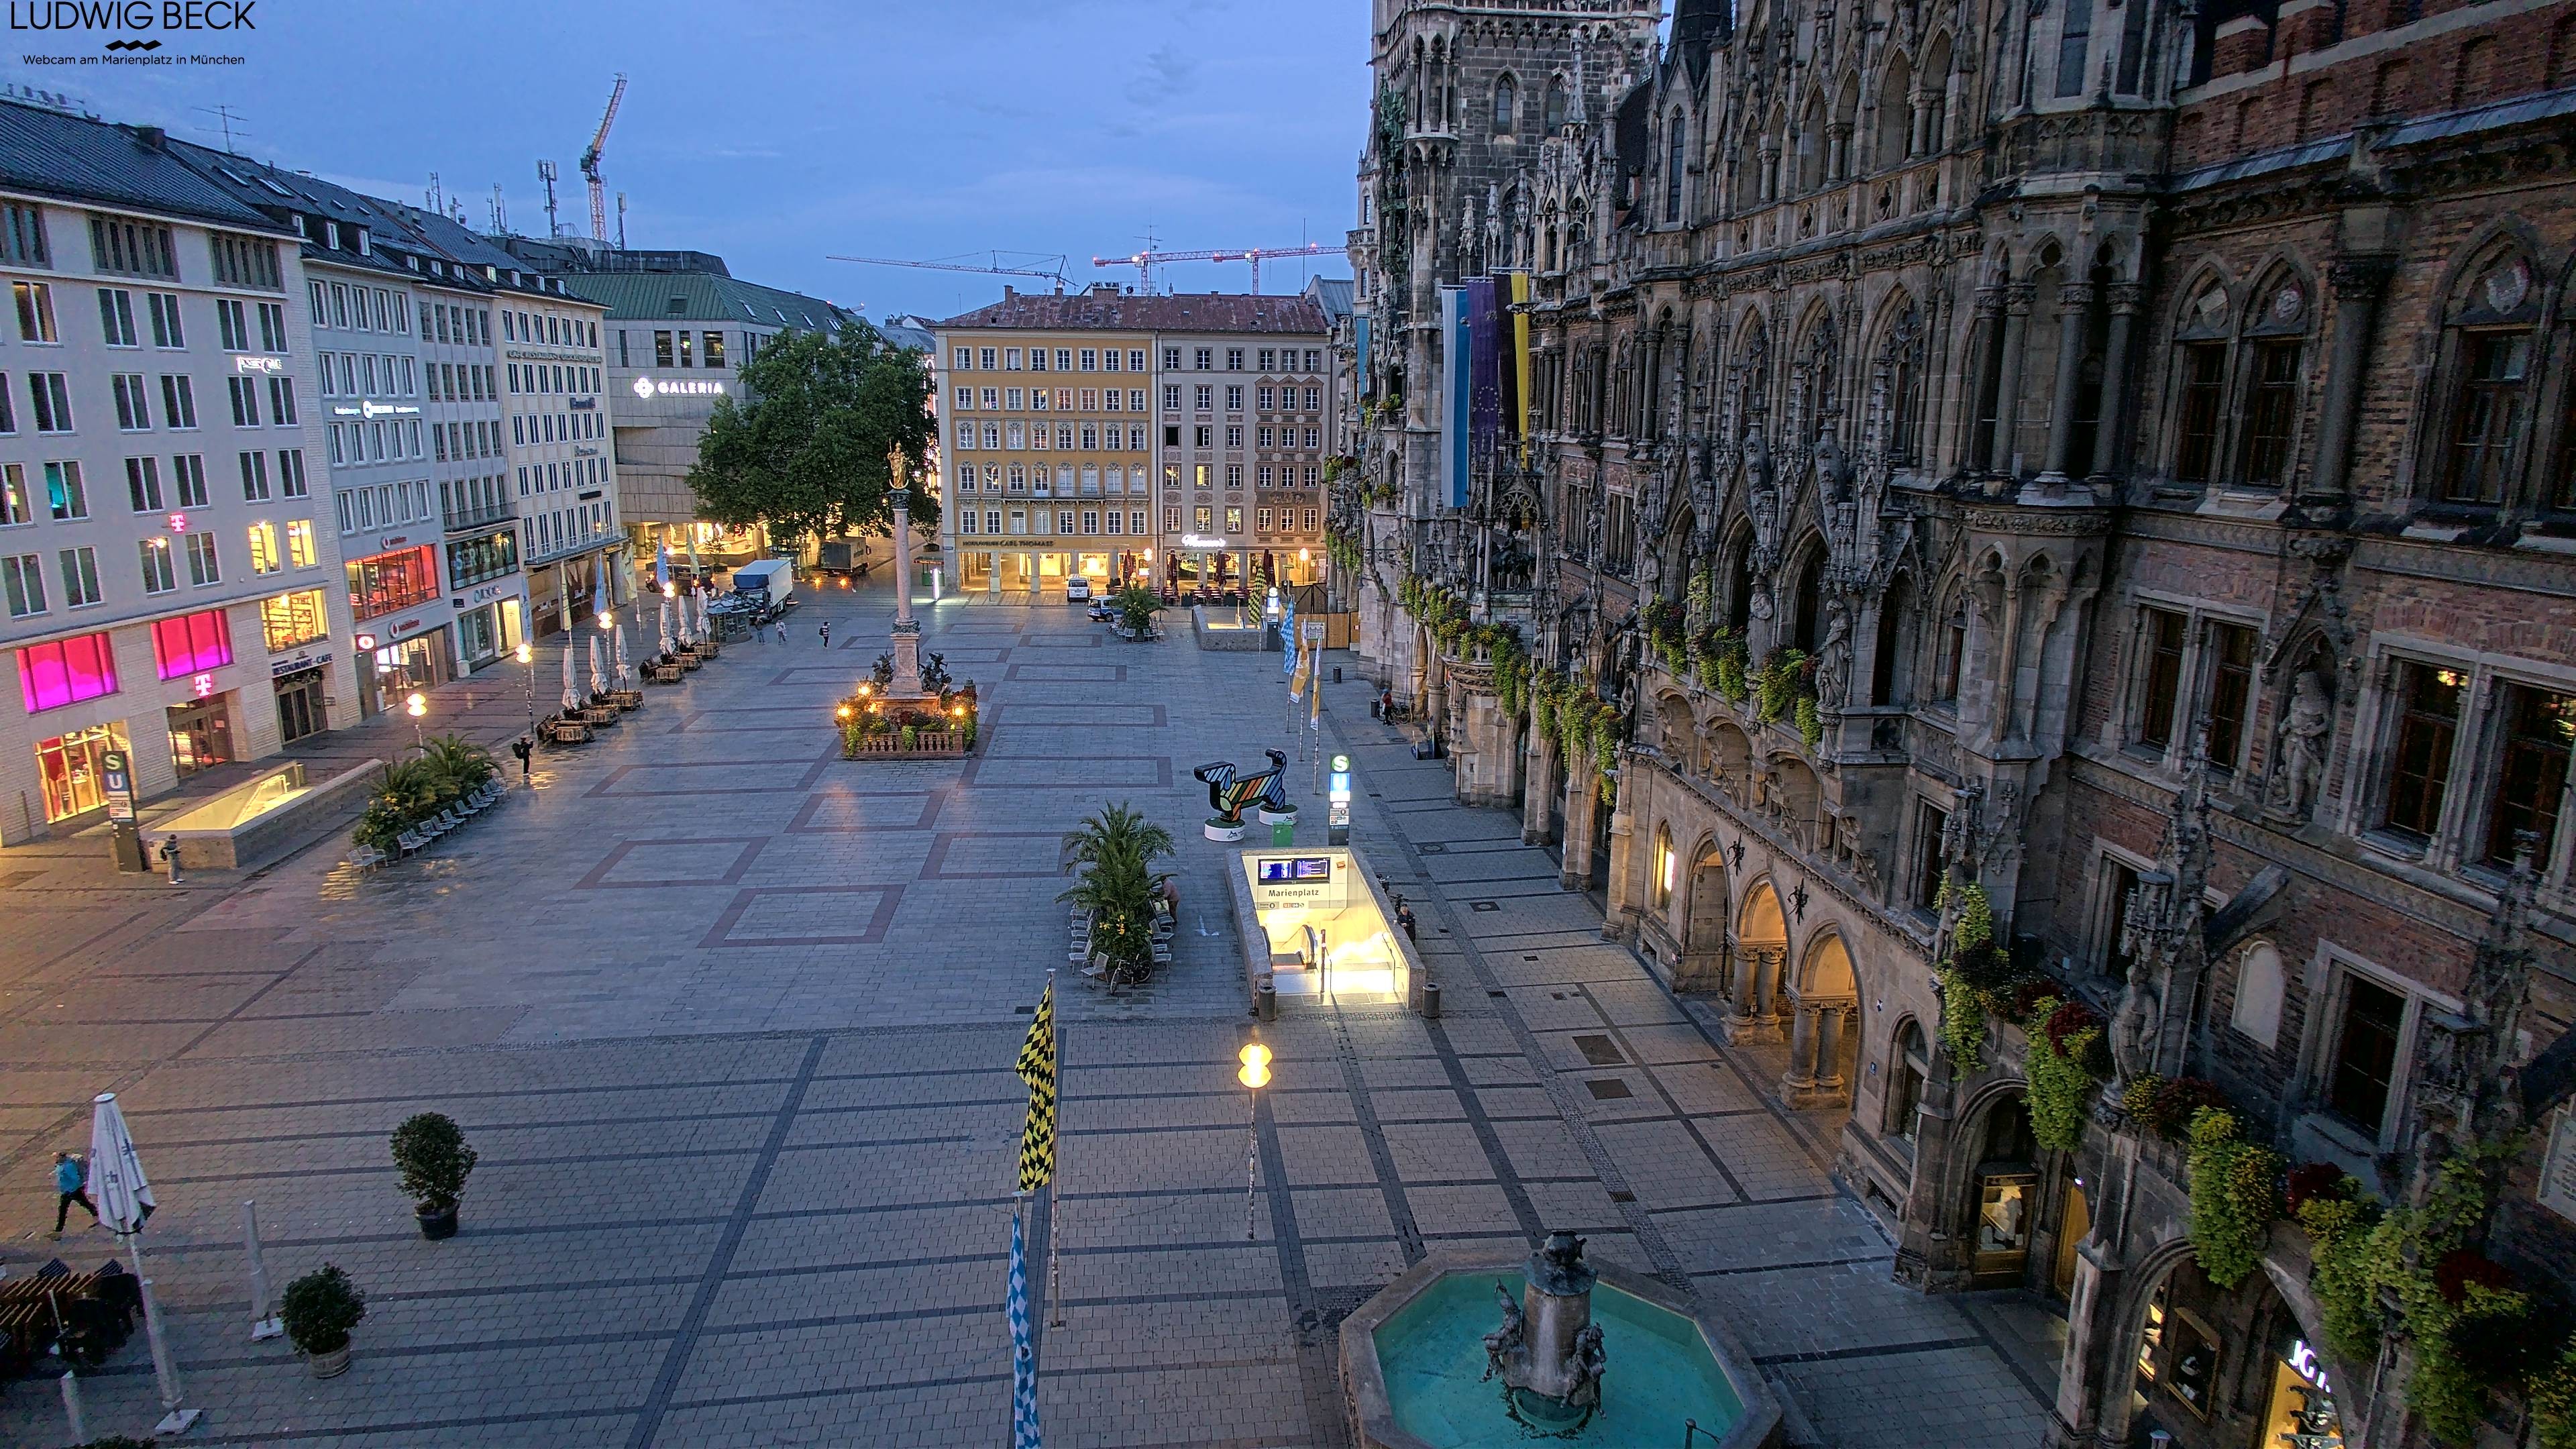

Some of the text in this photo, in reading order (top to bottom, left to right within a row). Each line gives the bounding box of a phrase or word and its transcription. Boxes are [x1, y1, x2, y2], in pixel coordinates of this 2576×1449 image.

[657, 382, 724, 394] GALERIA
[105, 755, 121, 769] S
[1334, 755, 1348, 772] S
[108, 774, 123, 789] U
[1332, 773, 1348, 791] U
[1269, 888, 1320, 898] Marienplatz
